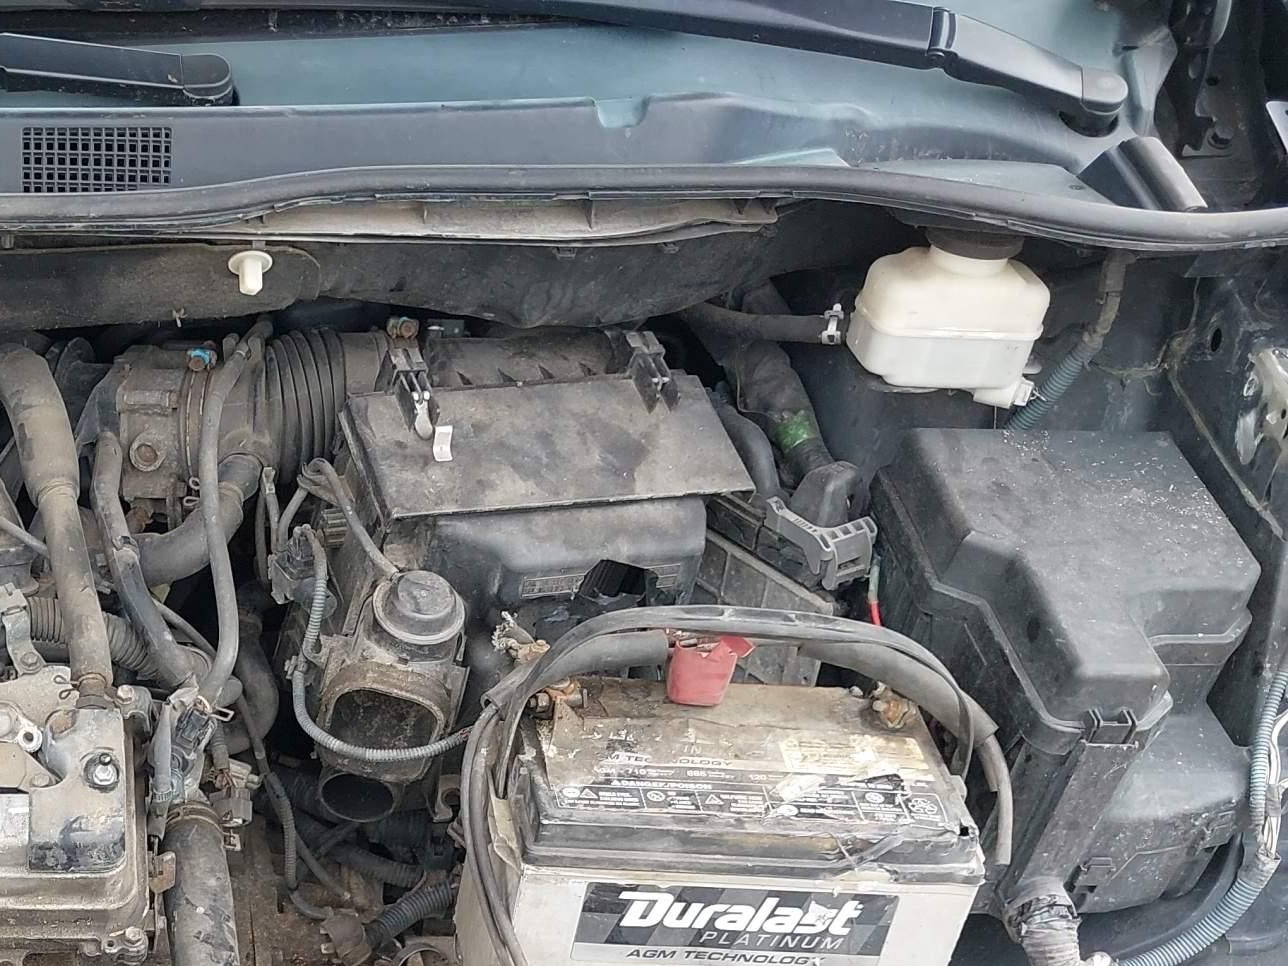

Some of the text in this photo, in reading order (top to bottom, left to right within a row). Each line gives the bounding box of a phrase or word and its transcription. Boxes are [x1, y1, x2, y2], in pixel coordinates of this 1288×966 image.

[619, 891, 865, 936] Duralast
[699, 930, 845, 950] PLATINUM
[626, 947, 676, 959] AGM
